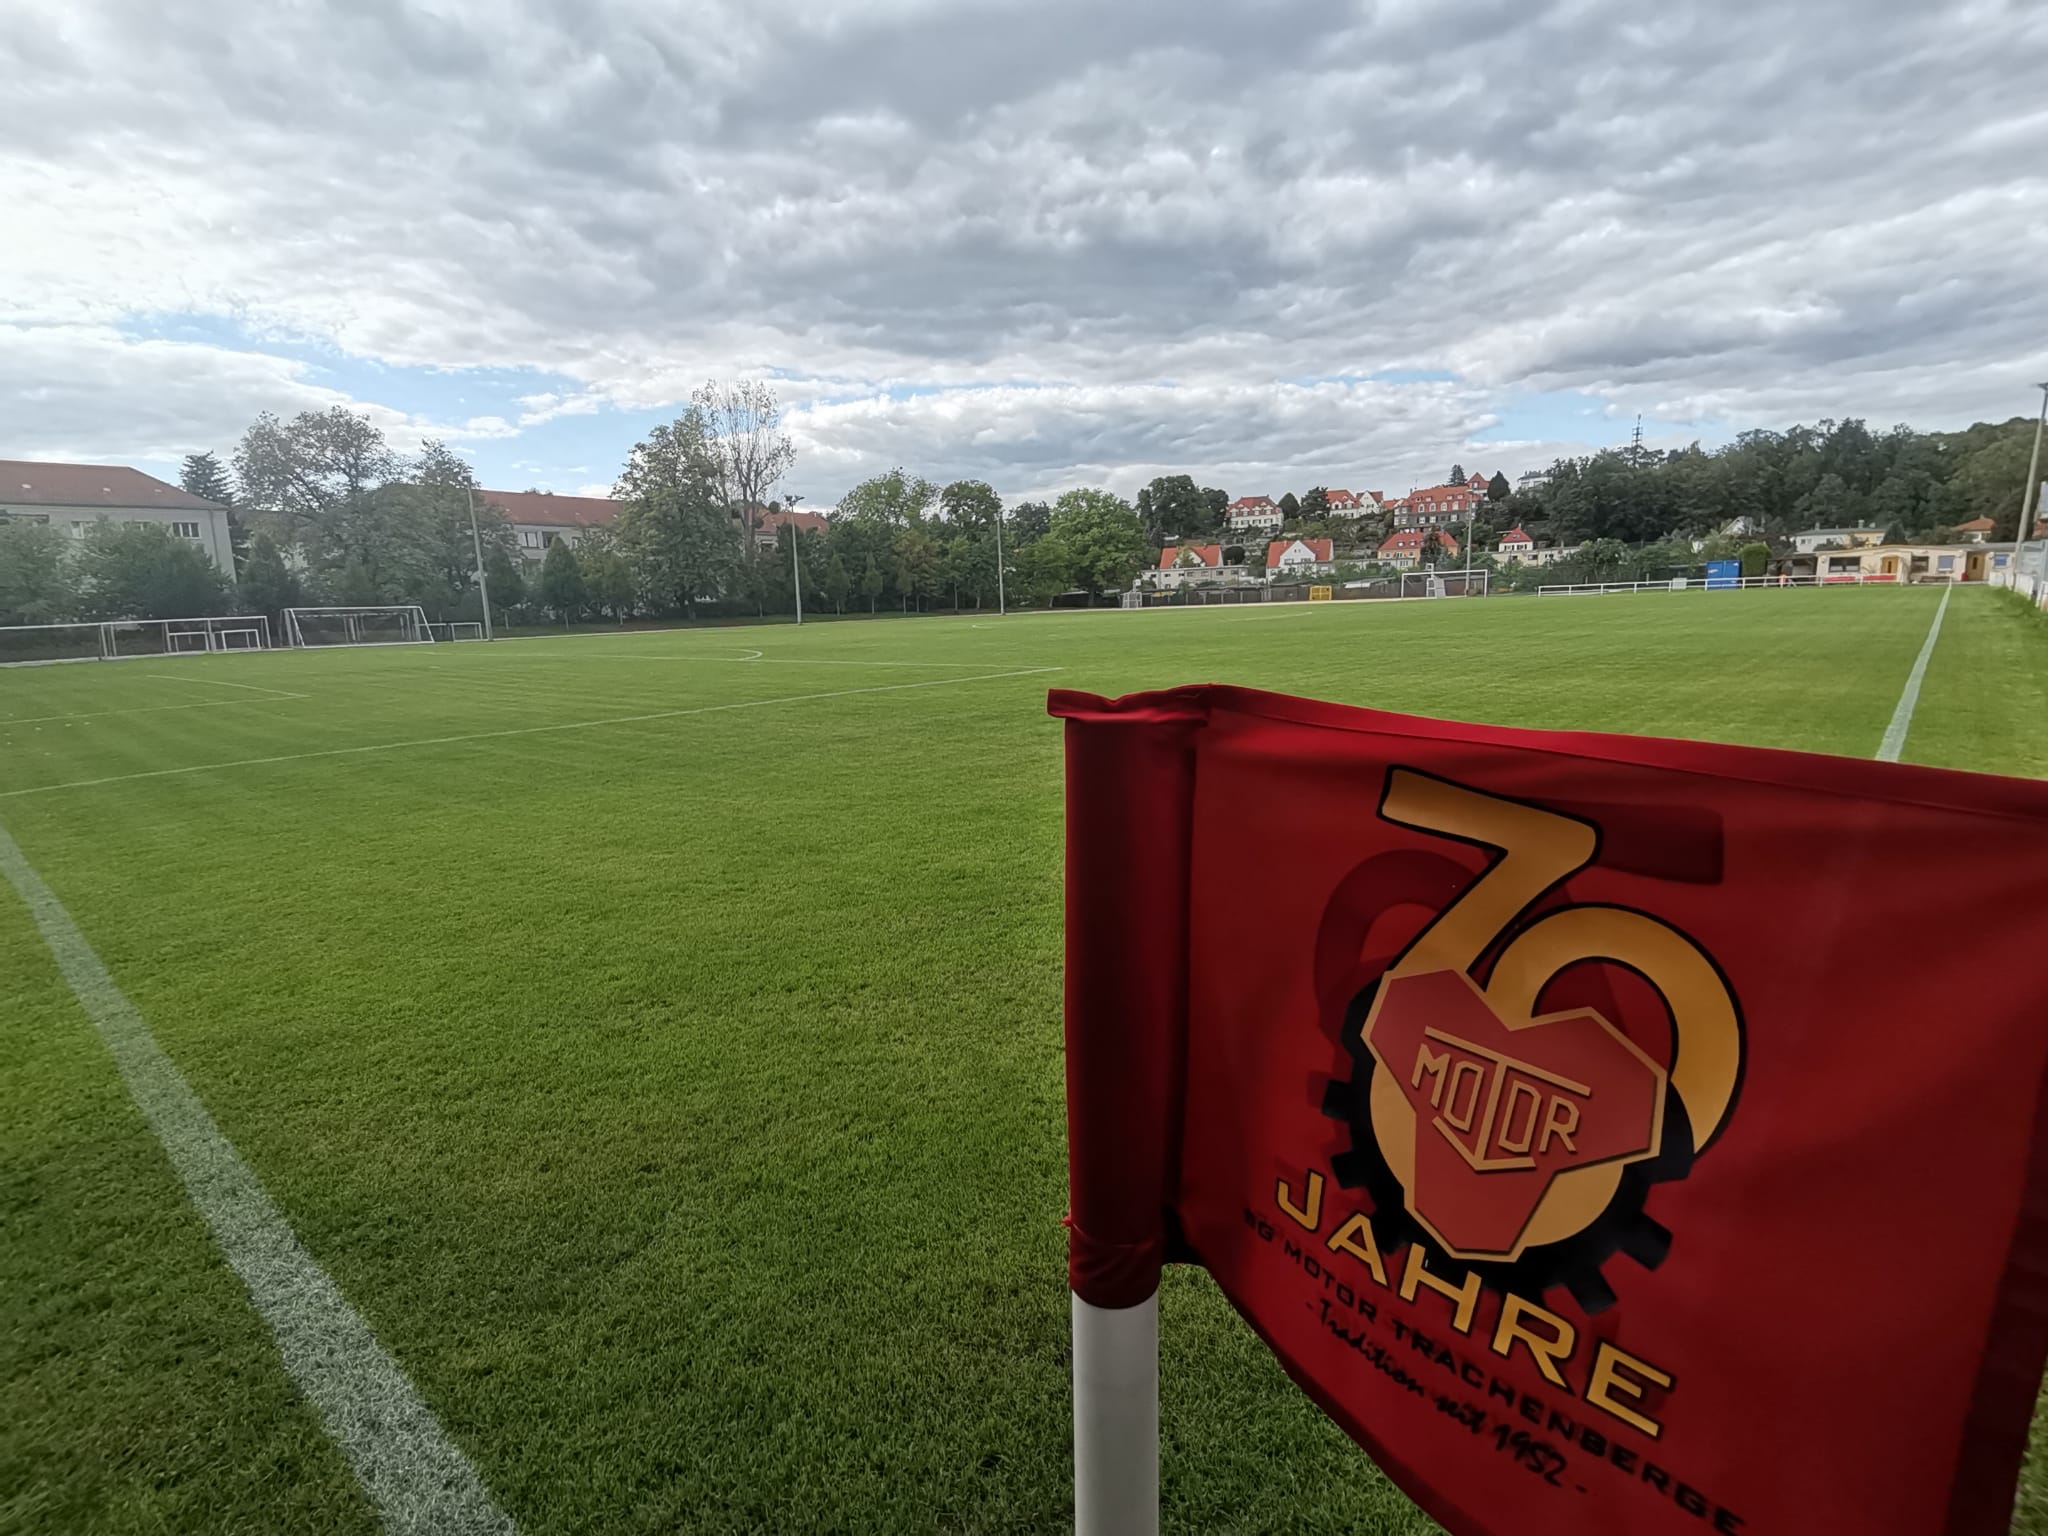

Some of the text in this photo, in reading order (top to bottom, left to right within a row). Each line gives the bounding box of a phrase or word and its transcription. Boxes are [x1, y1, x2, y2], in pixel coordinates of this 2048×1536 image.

[1410, 1025, 1591, 1172] MOTOR
[1275, 1168, 1677, 1440] JAHRE
[1283, 1239, 1378, 1324] MOTOR
[1391, 1317, 1746, 1536] TRACHENBERGE
